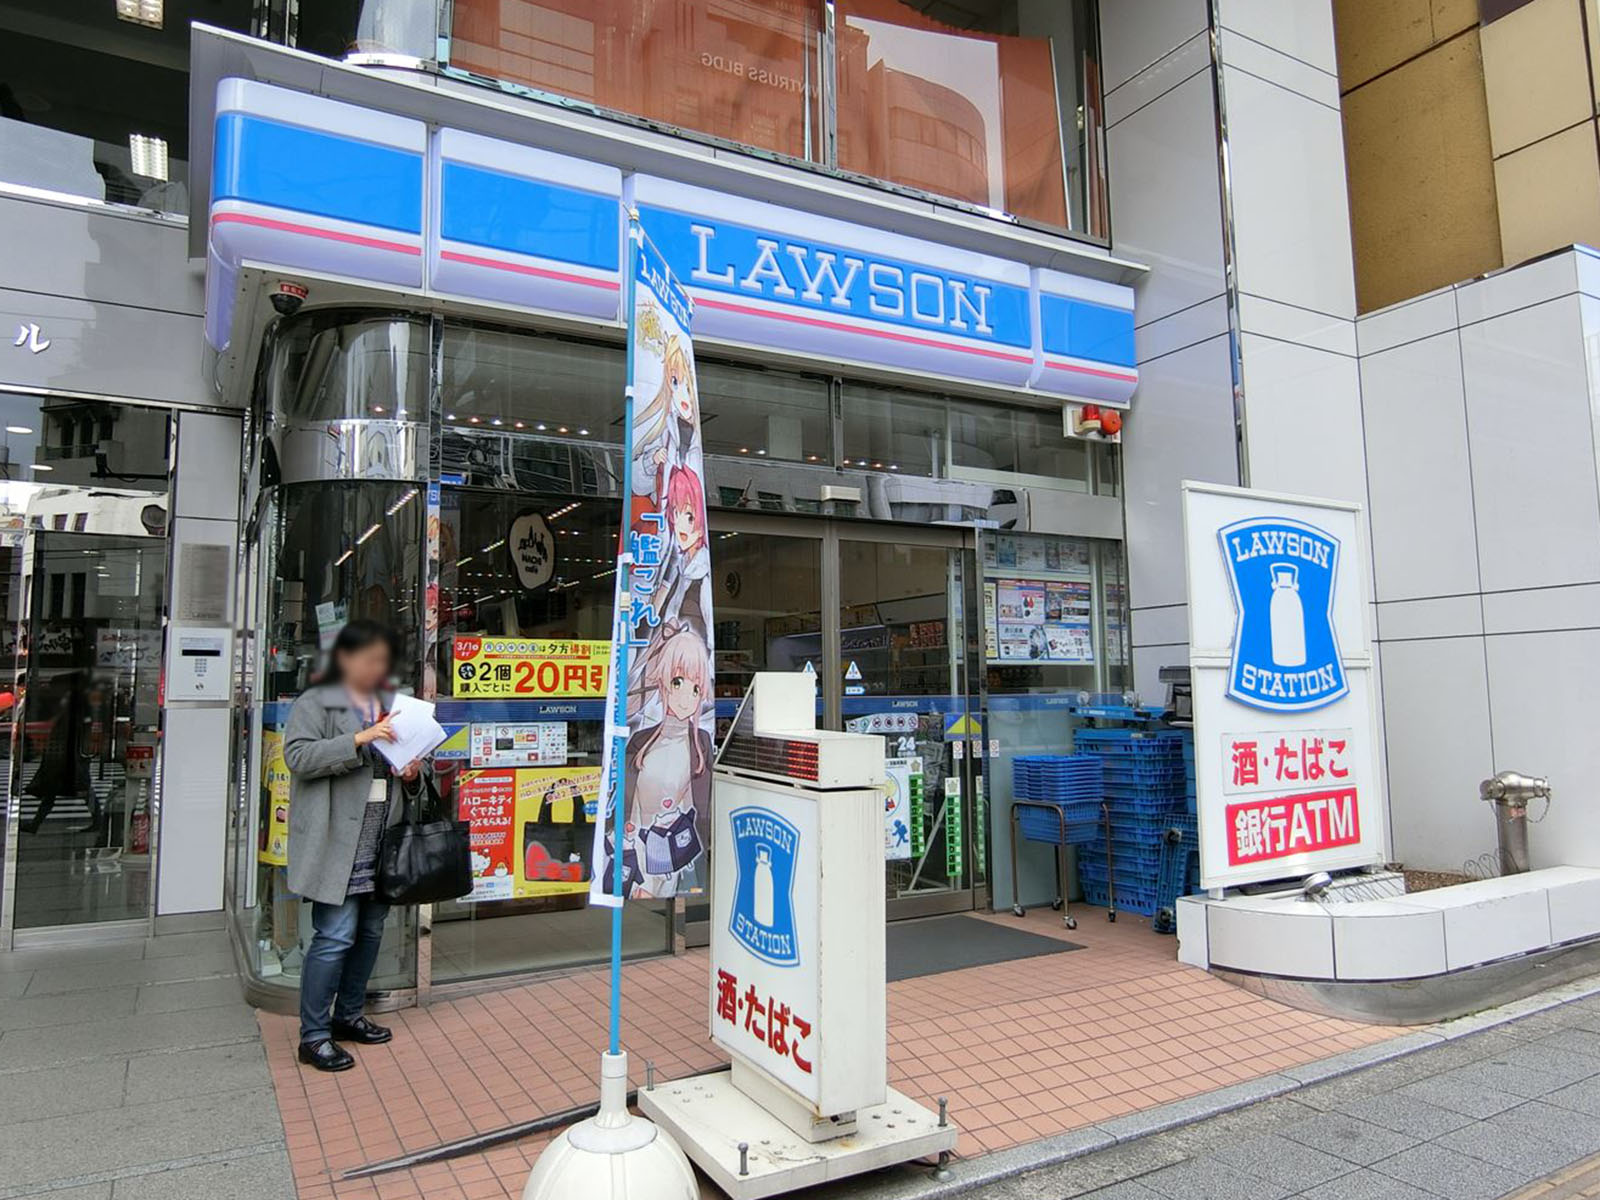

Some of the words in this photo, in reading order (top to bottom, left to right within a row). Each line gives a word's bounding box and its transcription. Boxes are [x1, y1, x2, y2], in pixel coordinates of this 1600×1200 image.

[691, 224, 993, 336] LAWSON
[14, 322, 51, 355] ル
[1231, 530, 1331, 569] LAWSON
[1241, 662, 1338, 698] STATION
[539, 705, 577, 714] LAWSON
[897, 736, 916, 751] 24
[1231, 738, 1349, 786] 酒・たばこ
[463, 795, 513, 806] ハローキティ
[470, 805, 504, 816] ぐでたま
[735, 817, 794, 855] LAWSON
[1234, 795, 1354, 858] 銀行ATM
[736, 912, 792, 955] STATION
[717, 967, 813, 1075] 酒・たばこ
